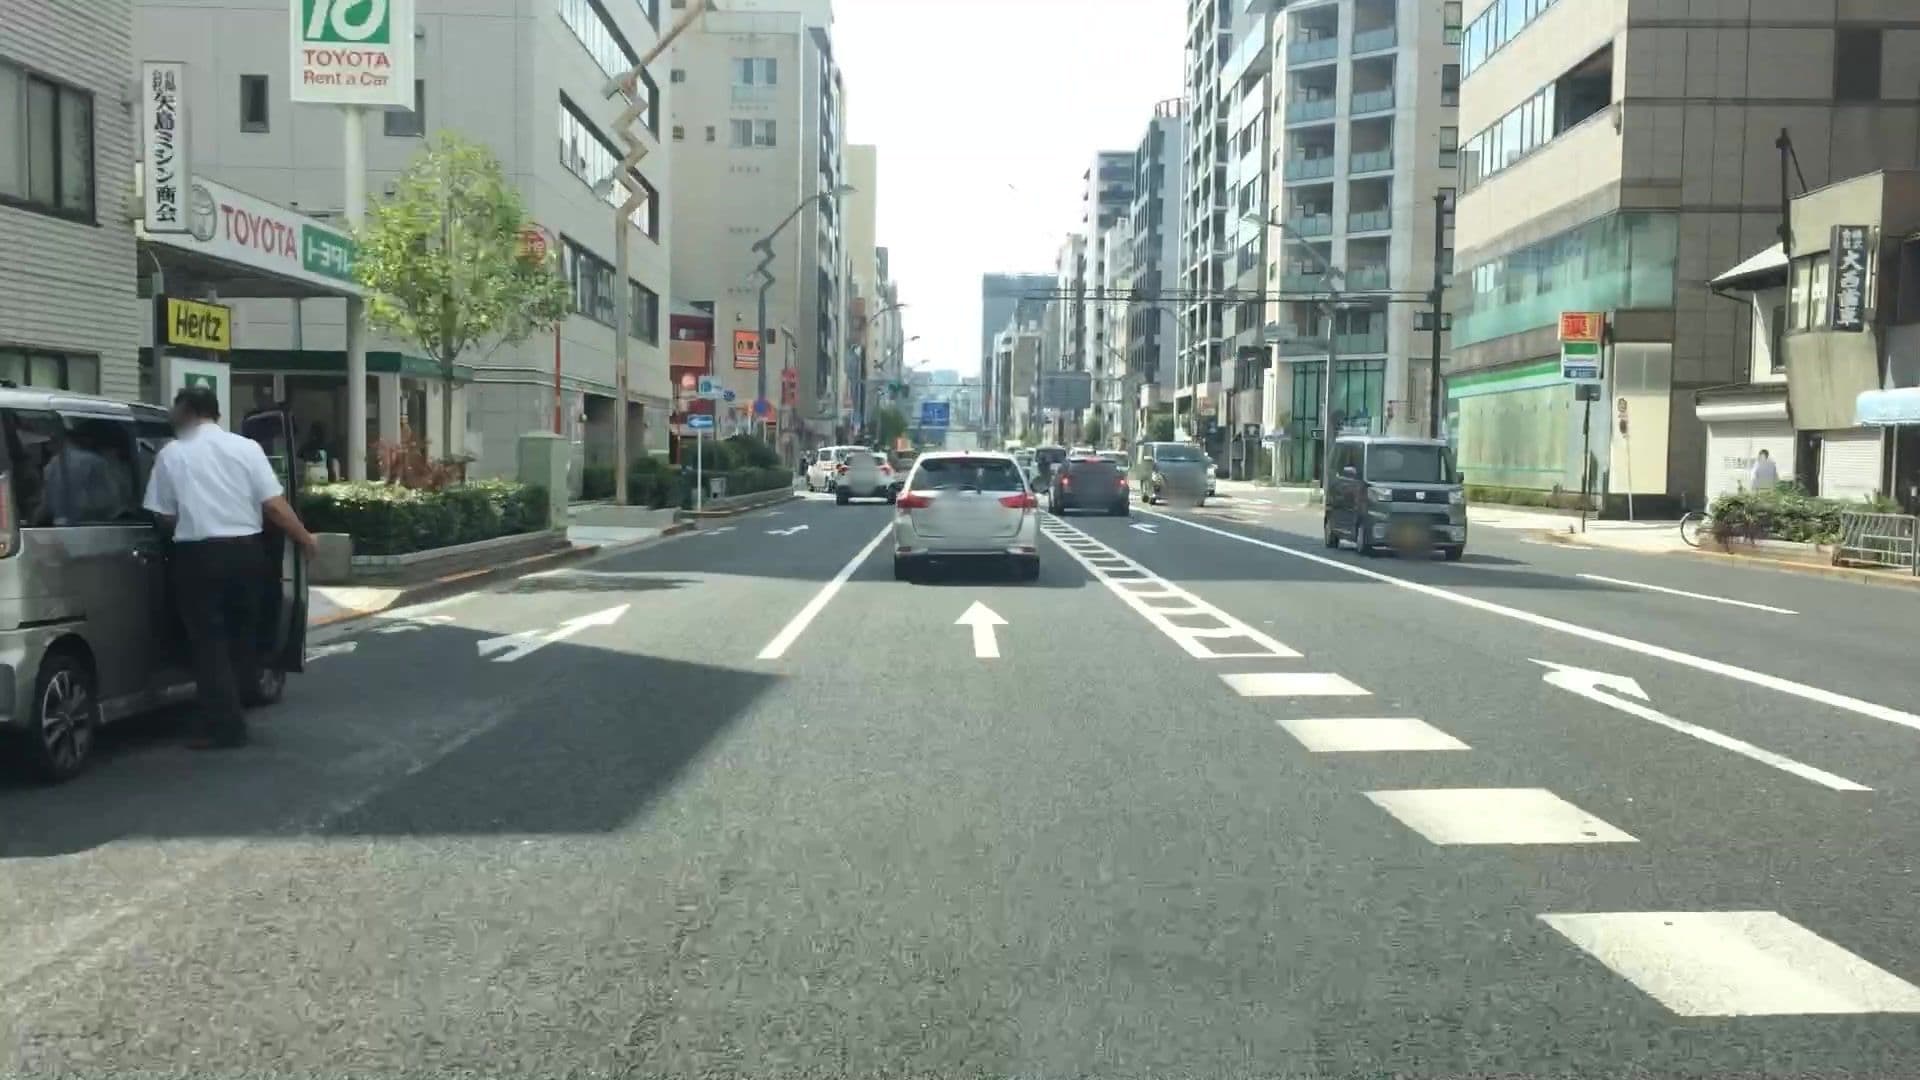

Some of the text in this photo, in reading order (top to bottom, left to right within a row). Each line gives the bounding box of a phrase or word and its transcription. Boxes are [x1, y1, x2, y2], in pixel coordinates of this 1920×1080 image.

[303, 49, 391, 67] TOYOTA
[303, 69, 389, 86] Rent a Car
[220, 204, 298, 261] TOYOTA
[176, 303, 222, 341] Hertz
